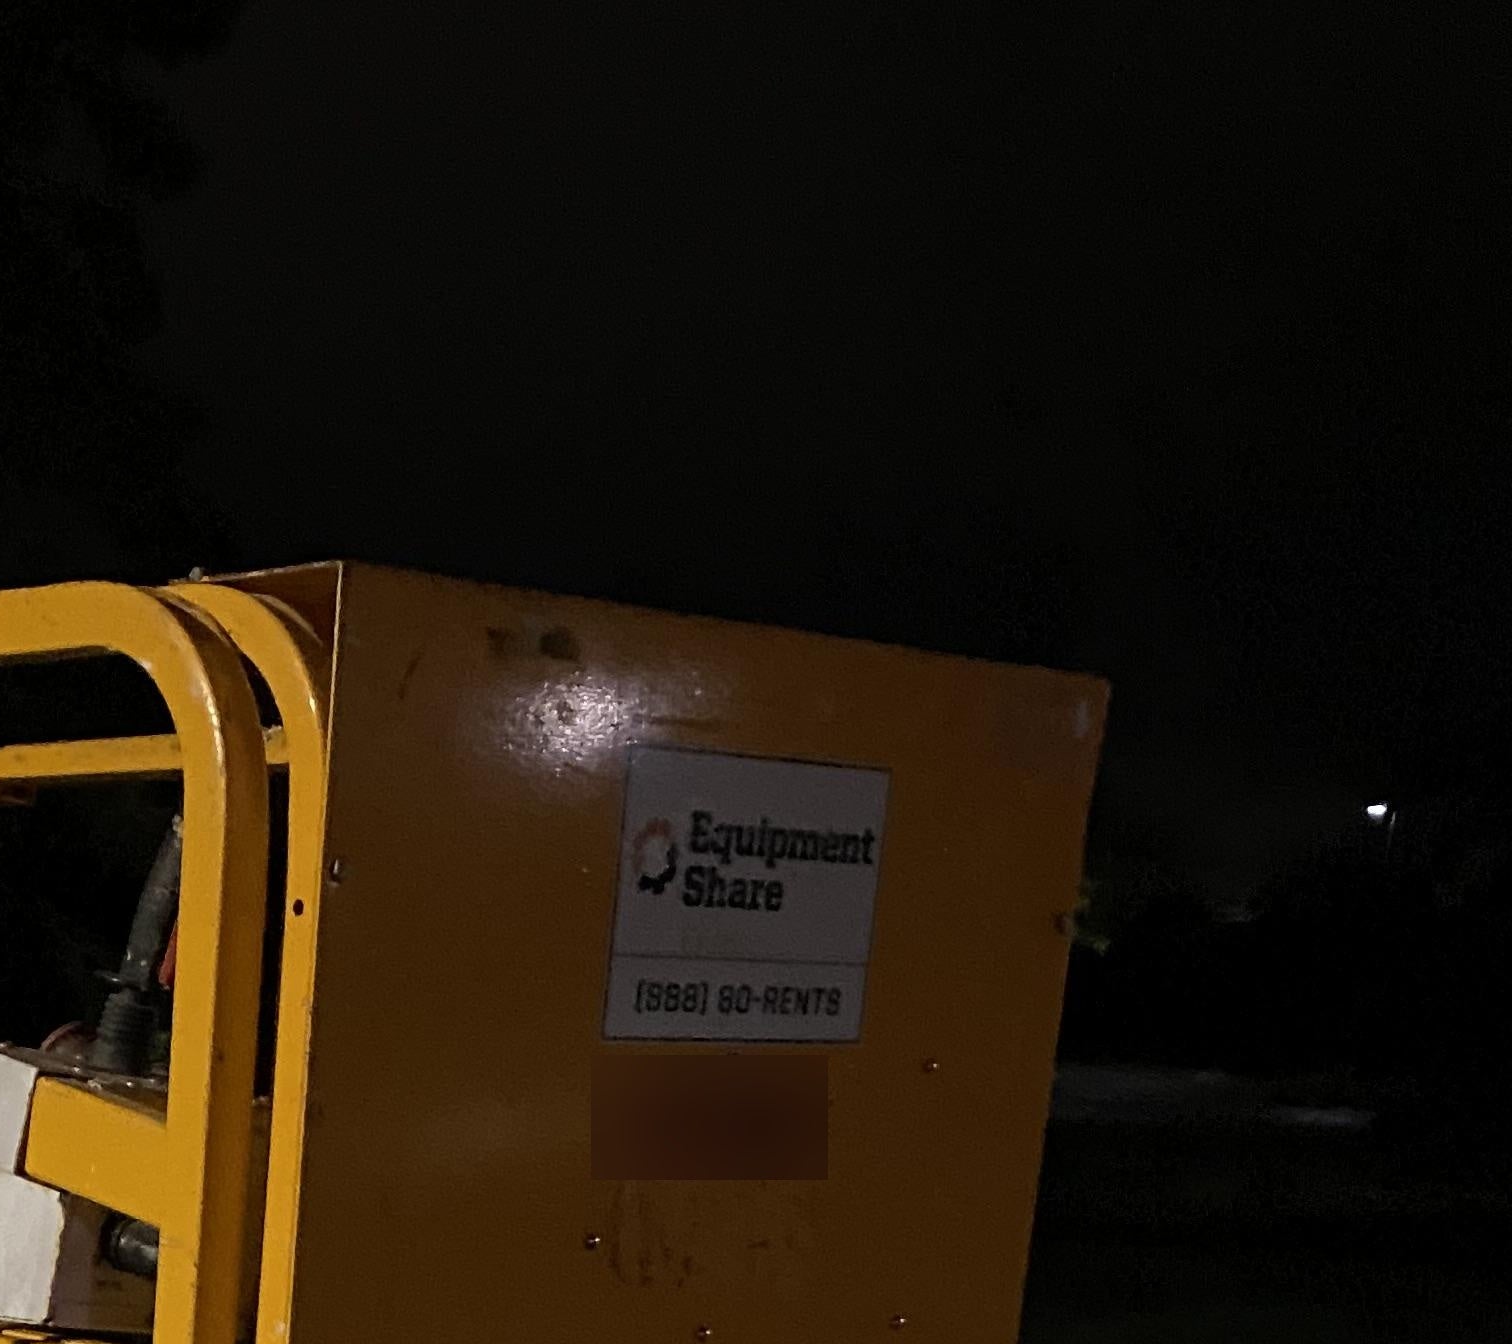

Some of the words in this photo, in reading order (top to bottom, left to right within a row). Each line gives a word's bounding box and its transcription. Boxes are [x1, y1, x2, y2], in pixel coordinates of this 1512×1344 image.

[690, 810, 875, 870] Equipment
[682, 865, 784, 912] Share
[635, 978, 710, 1016] (888)
[717, 984, 842, 1016] 80-RENTS
